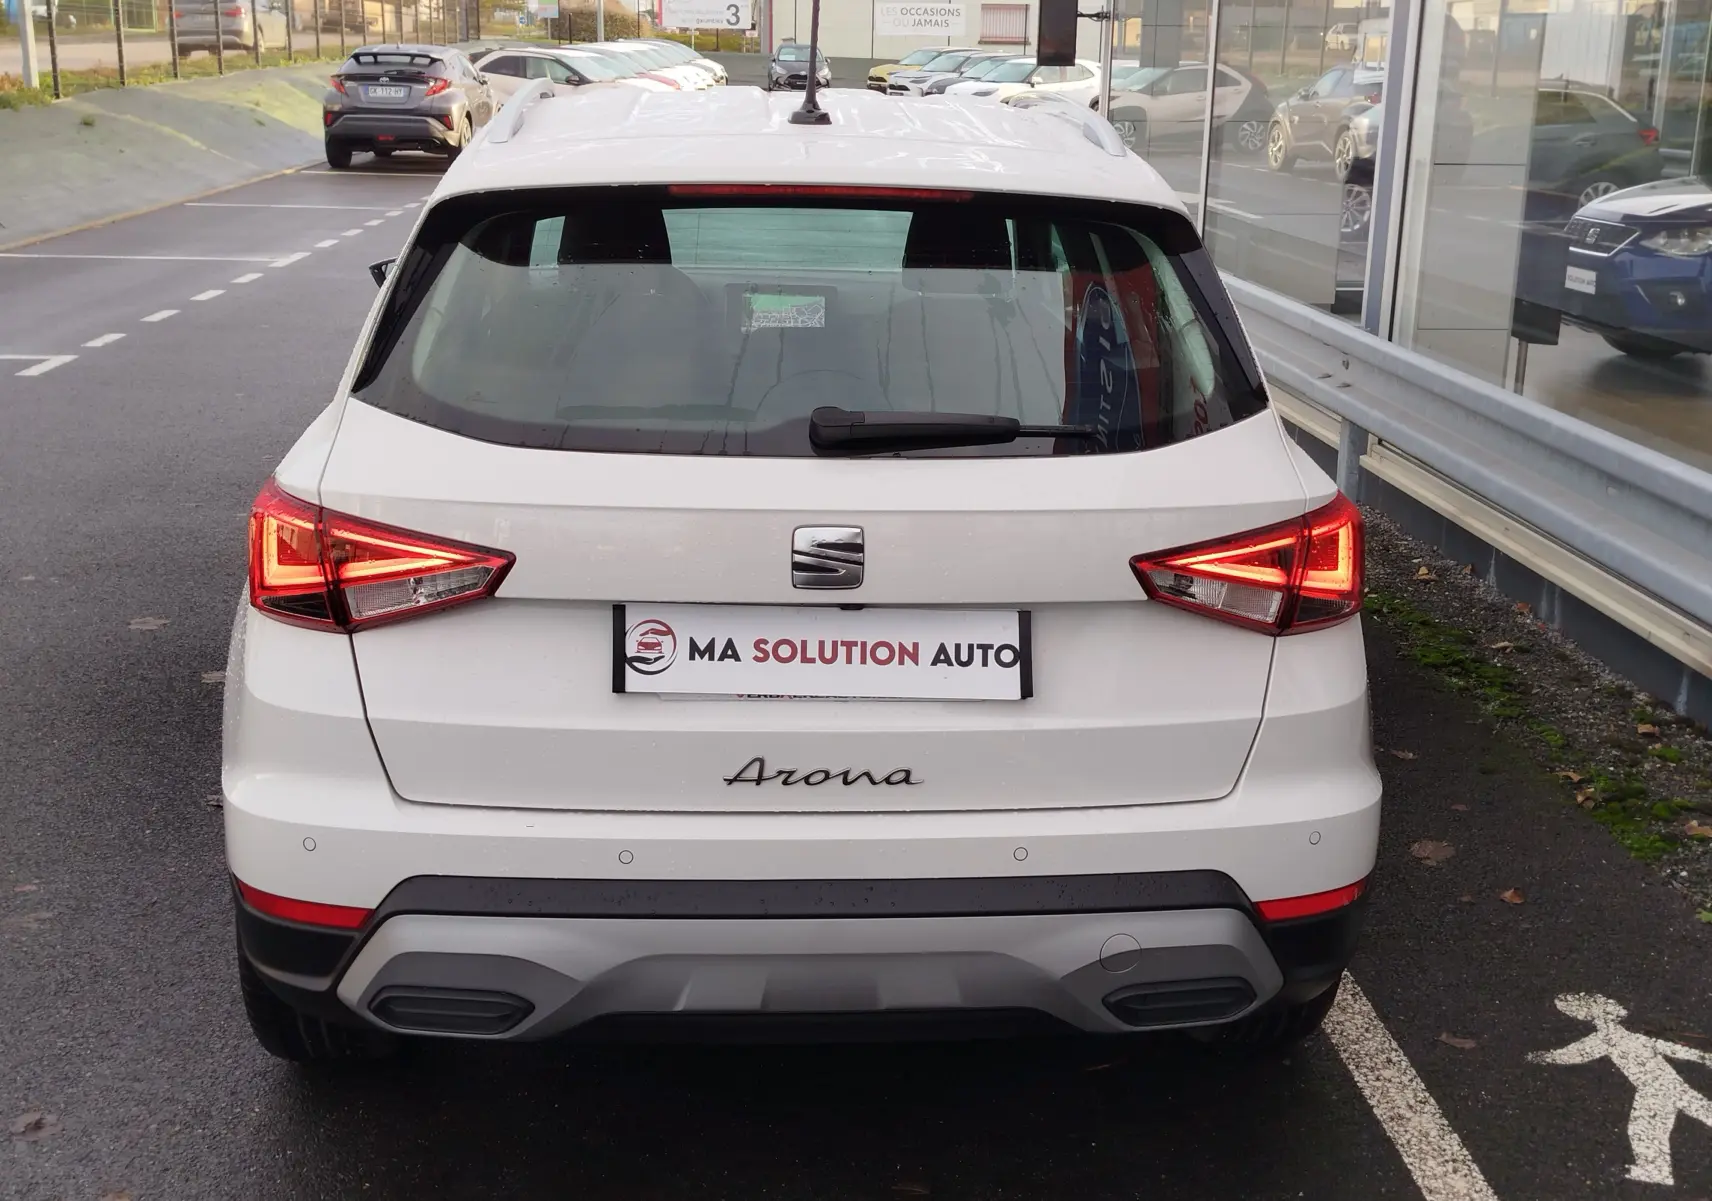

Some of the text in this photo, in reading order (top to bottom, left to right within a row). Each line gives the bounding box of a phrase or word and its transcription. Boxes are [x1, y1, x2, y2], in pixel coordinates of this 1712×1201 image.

[726, 3, 740, 26] 3
[881, 7, 961, 17] LES OCCASIONS
[893, 18, 949, 28] OU JAMAIS
[689, 636, 1020, 668] MA SOLUTION AUTO
[723, 755, 925, 786] Arona
